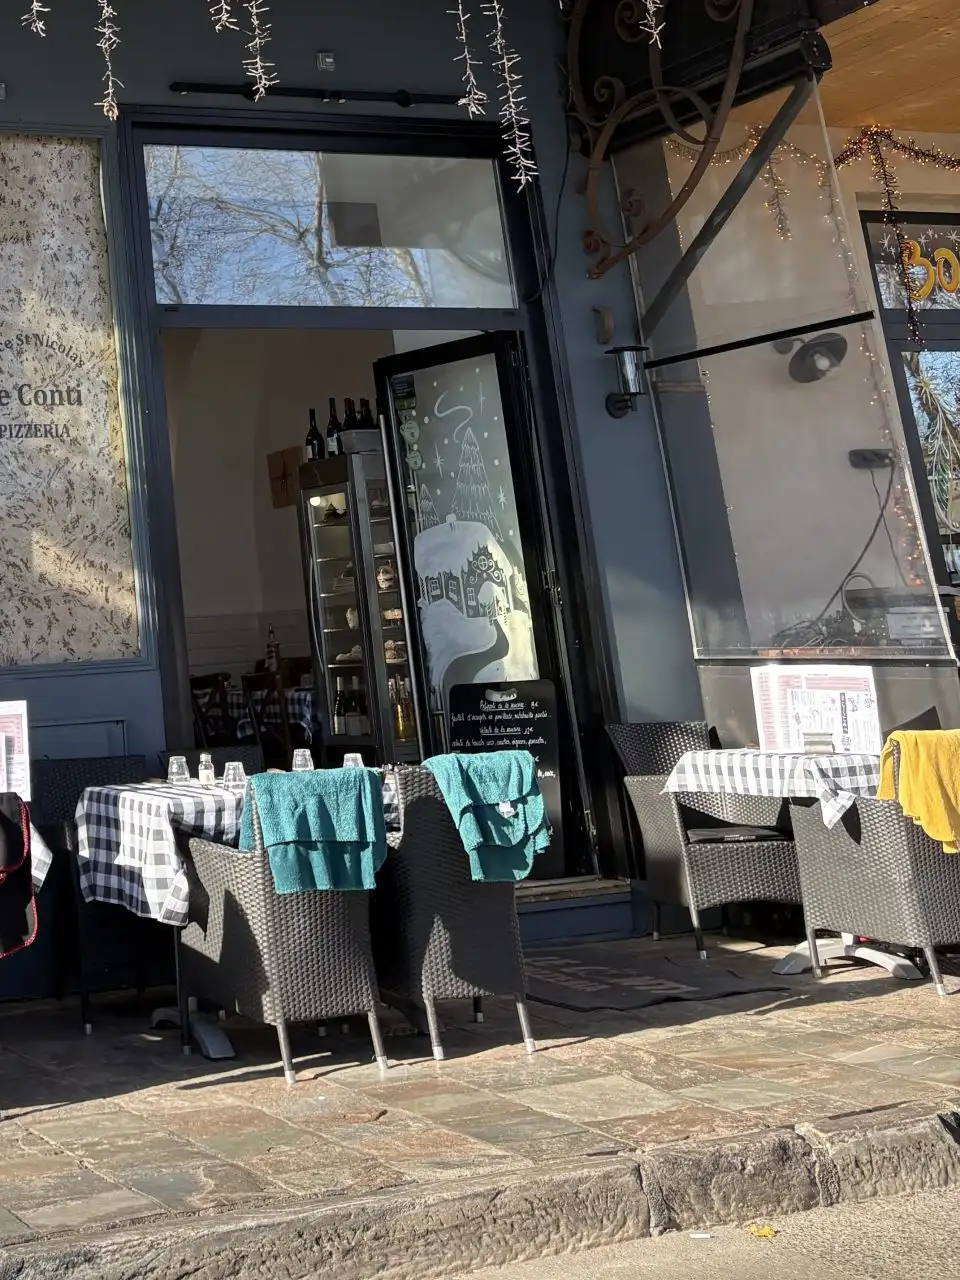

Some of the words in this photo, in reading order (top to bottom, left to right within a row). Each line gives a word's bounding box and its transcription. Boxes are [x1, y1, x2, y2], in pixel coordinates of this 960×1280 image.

[15, 333, 32, 346] St
[32, 333, 86, 369] Nicolas
[17, 383, 83, 407] Conti
